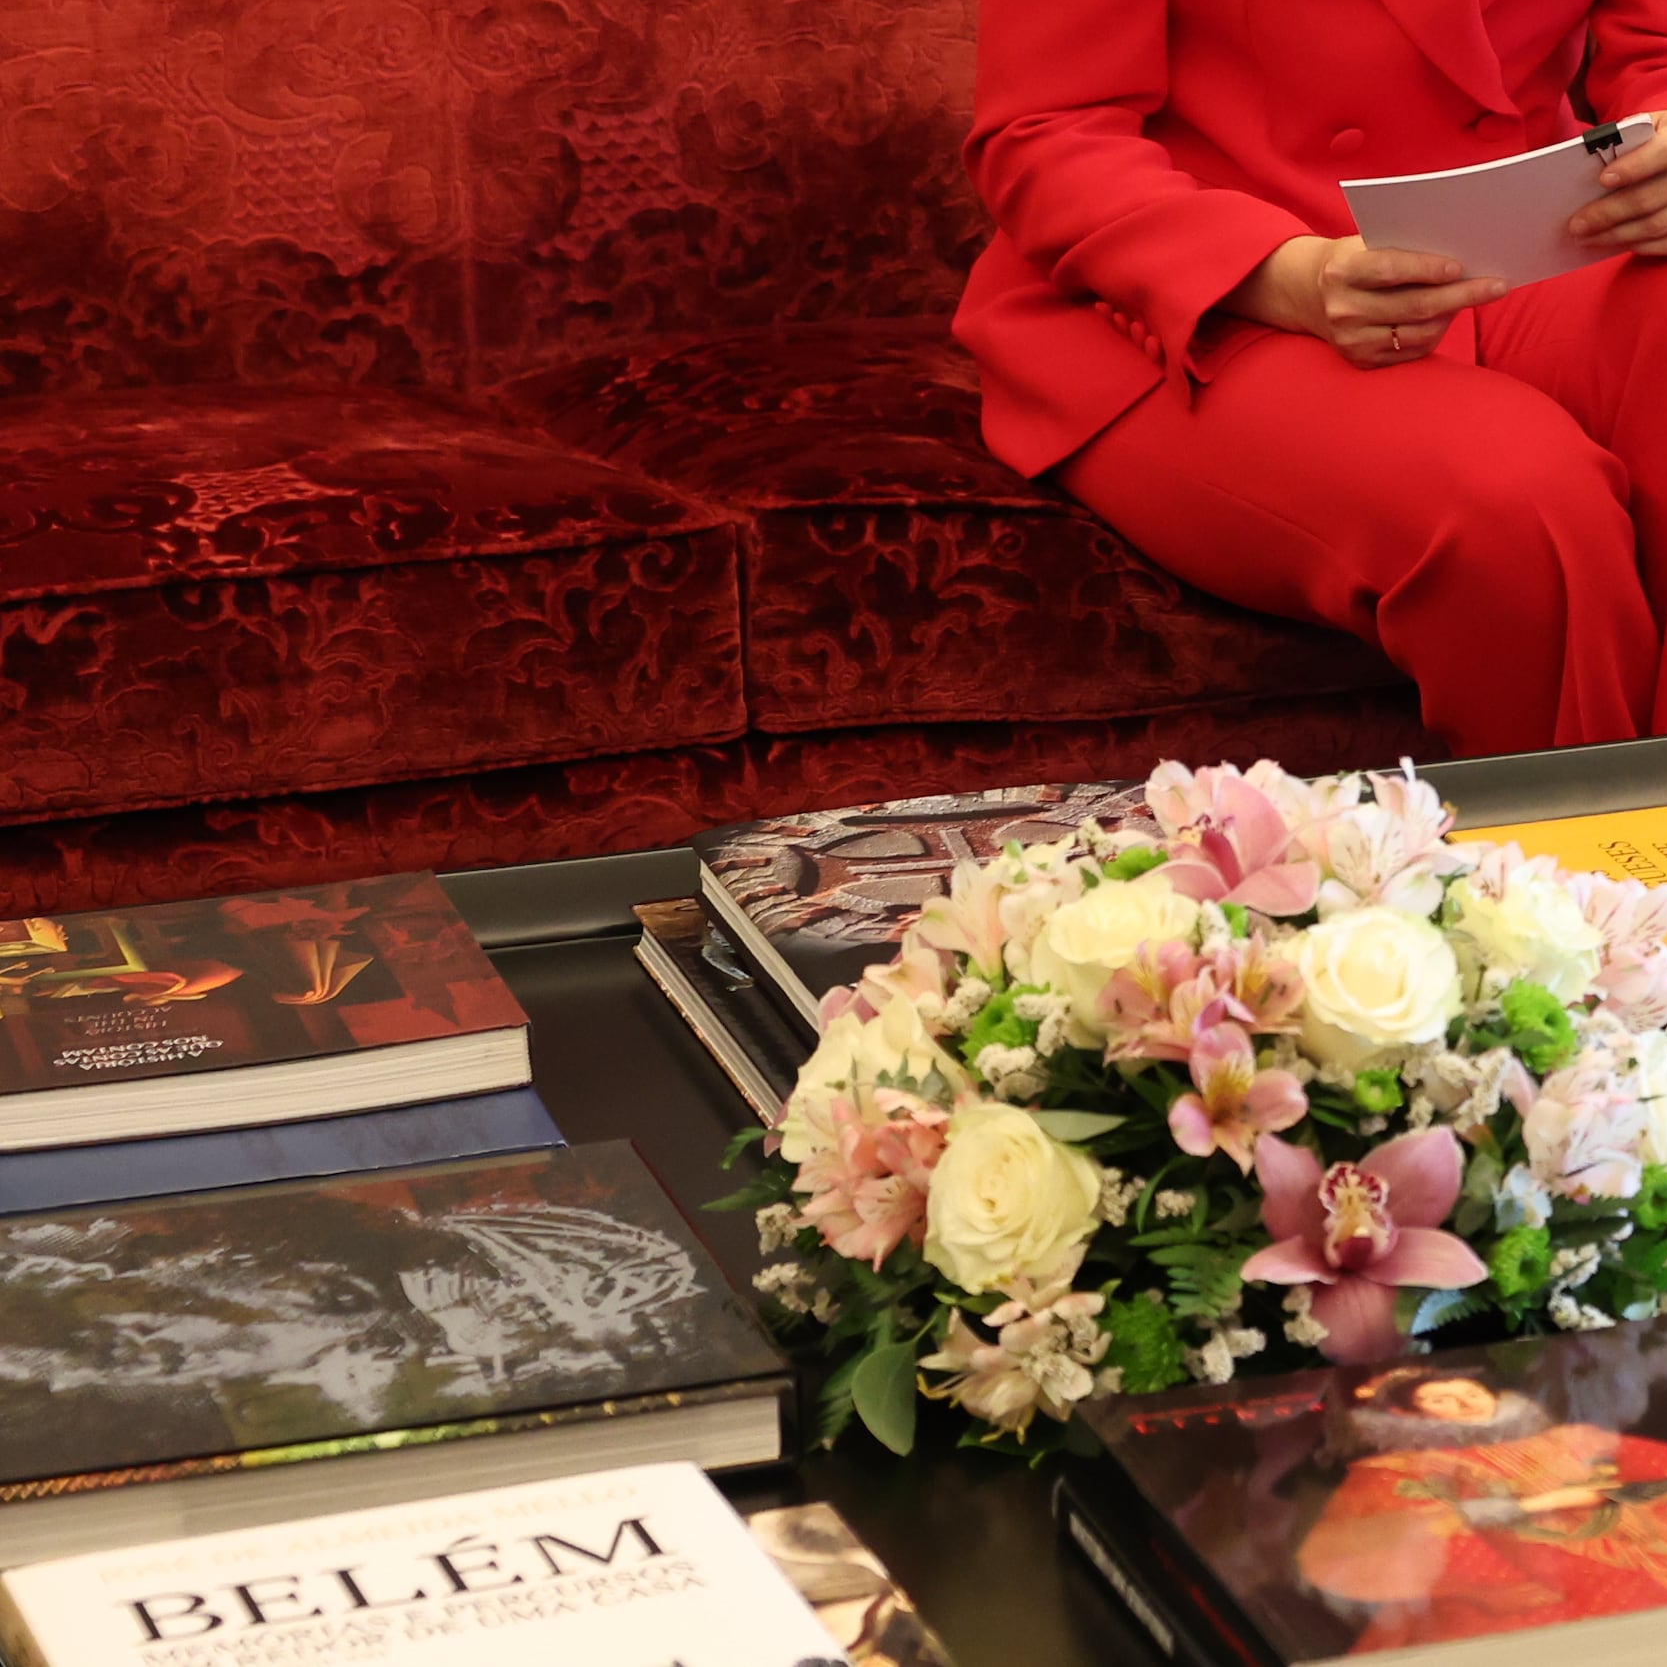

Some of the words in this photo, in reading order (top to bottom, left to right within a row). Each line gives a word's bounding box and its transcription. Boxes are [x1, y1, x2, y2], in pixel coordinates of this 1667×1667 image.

[161, 1033, 209, 1047] NOS
[176, 1039, 224, 1053] QUE
[52, 1049, 143, 1067] CONTAS
[61, 1040, 159, 1059] CONTAM
[145, 1045, 172, 1056] AS
[113, 1515, 682, 1643] BELÉM
[440, 1560, 697, 1622] PERCURSOS
[592, 1576, 708, 1606] CASA
